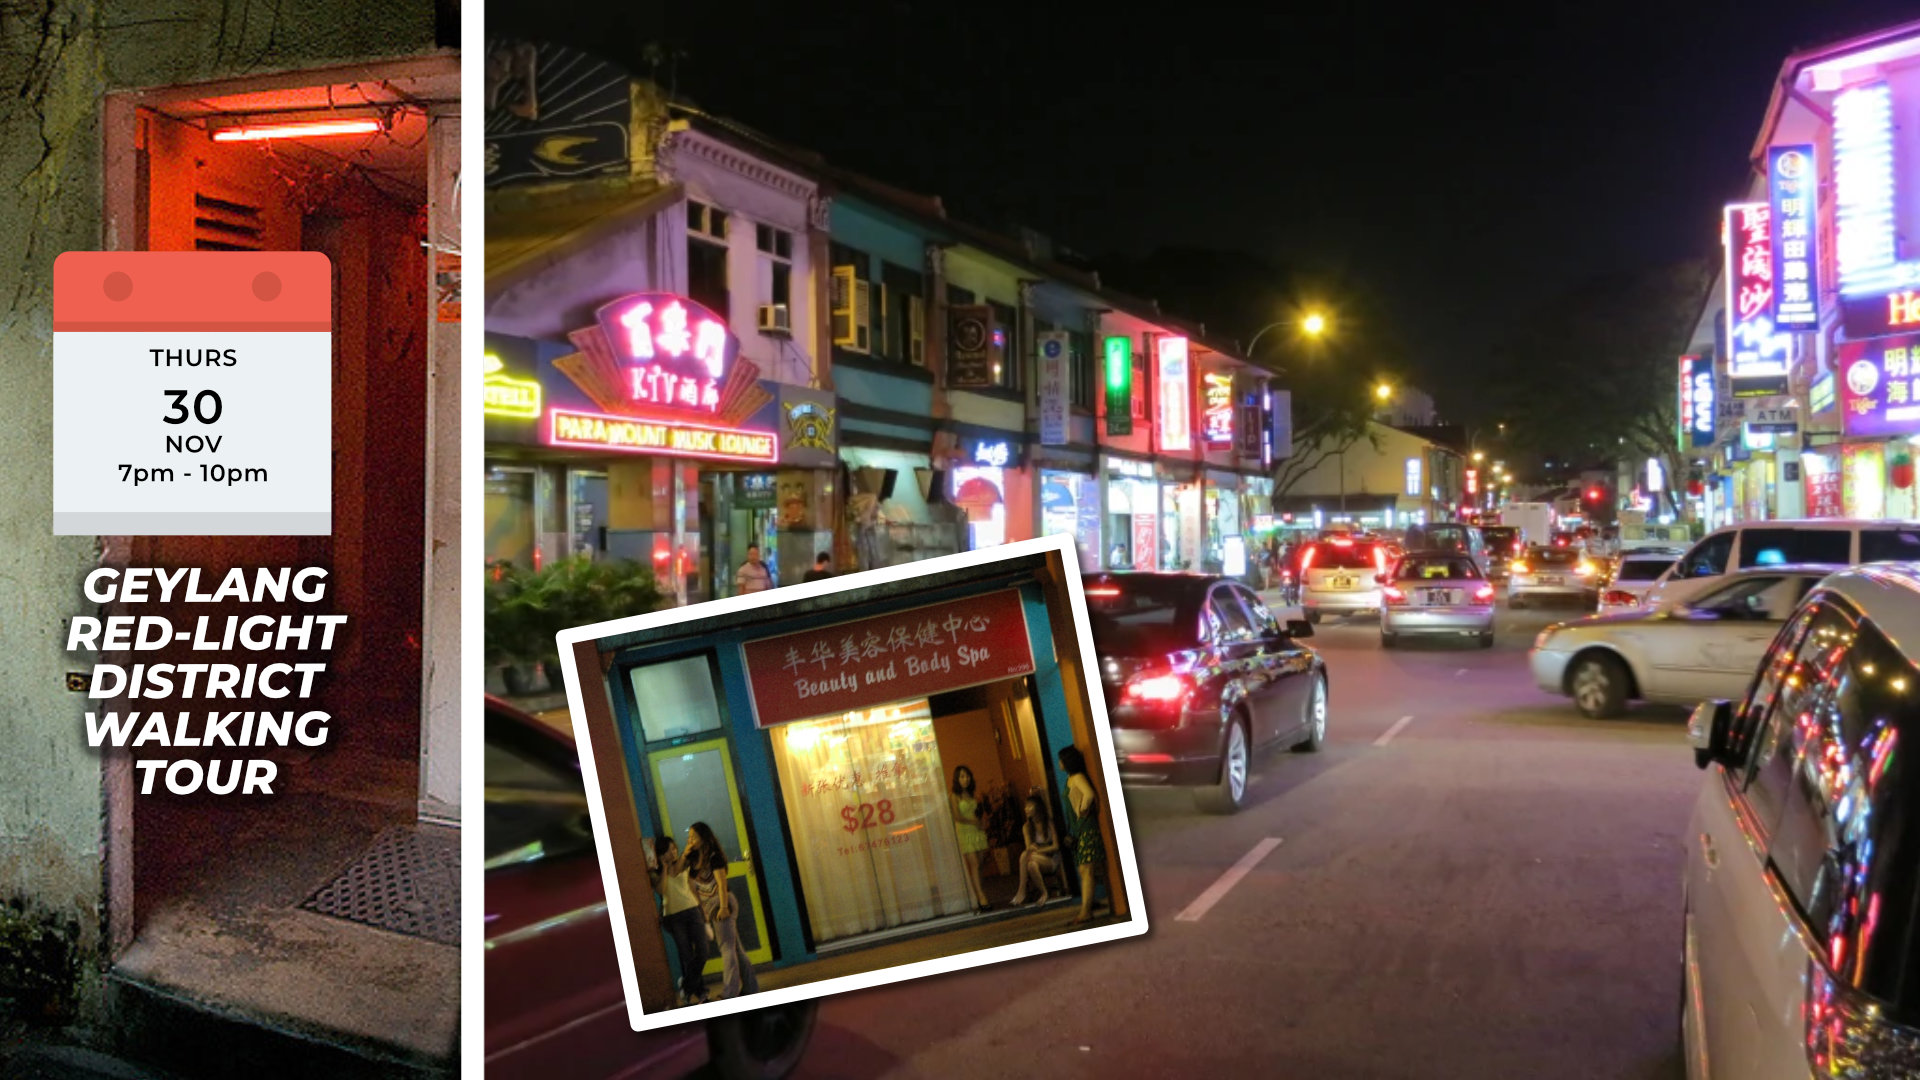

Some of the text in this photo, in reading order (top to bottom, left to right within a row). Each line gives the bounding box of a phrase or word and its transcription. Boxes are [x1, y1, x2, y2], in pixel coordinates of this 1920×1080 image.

[558, 415, 773, 456] PARAMOUNT MUSIC LOUNGE
[1757, 409, 1792, 421] ATM
[782, 613, 991, 677] 丰华美容保健中心
[793, 644, 991, 700] Beauty and Body Spa
[840, 798, 896, 835] $28
